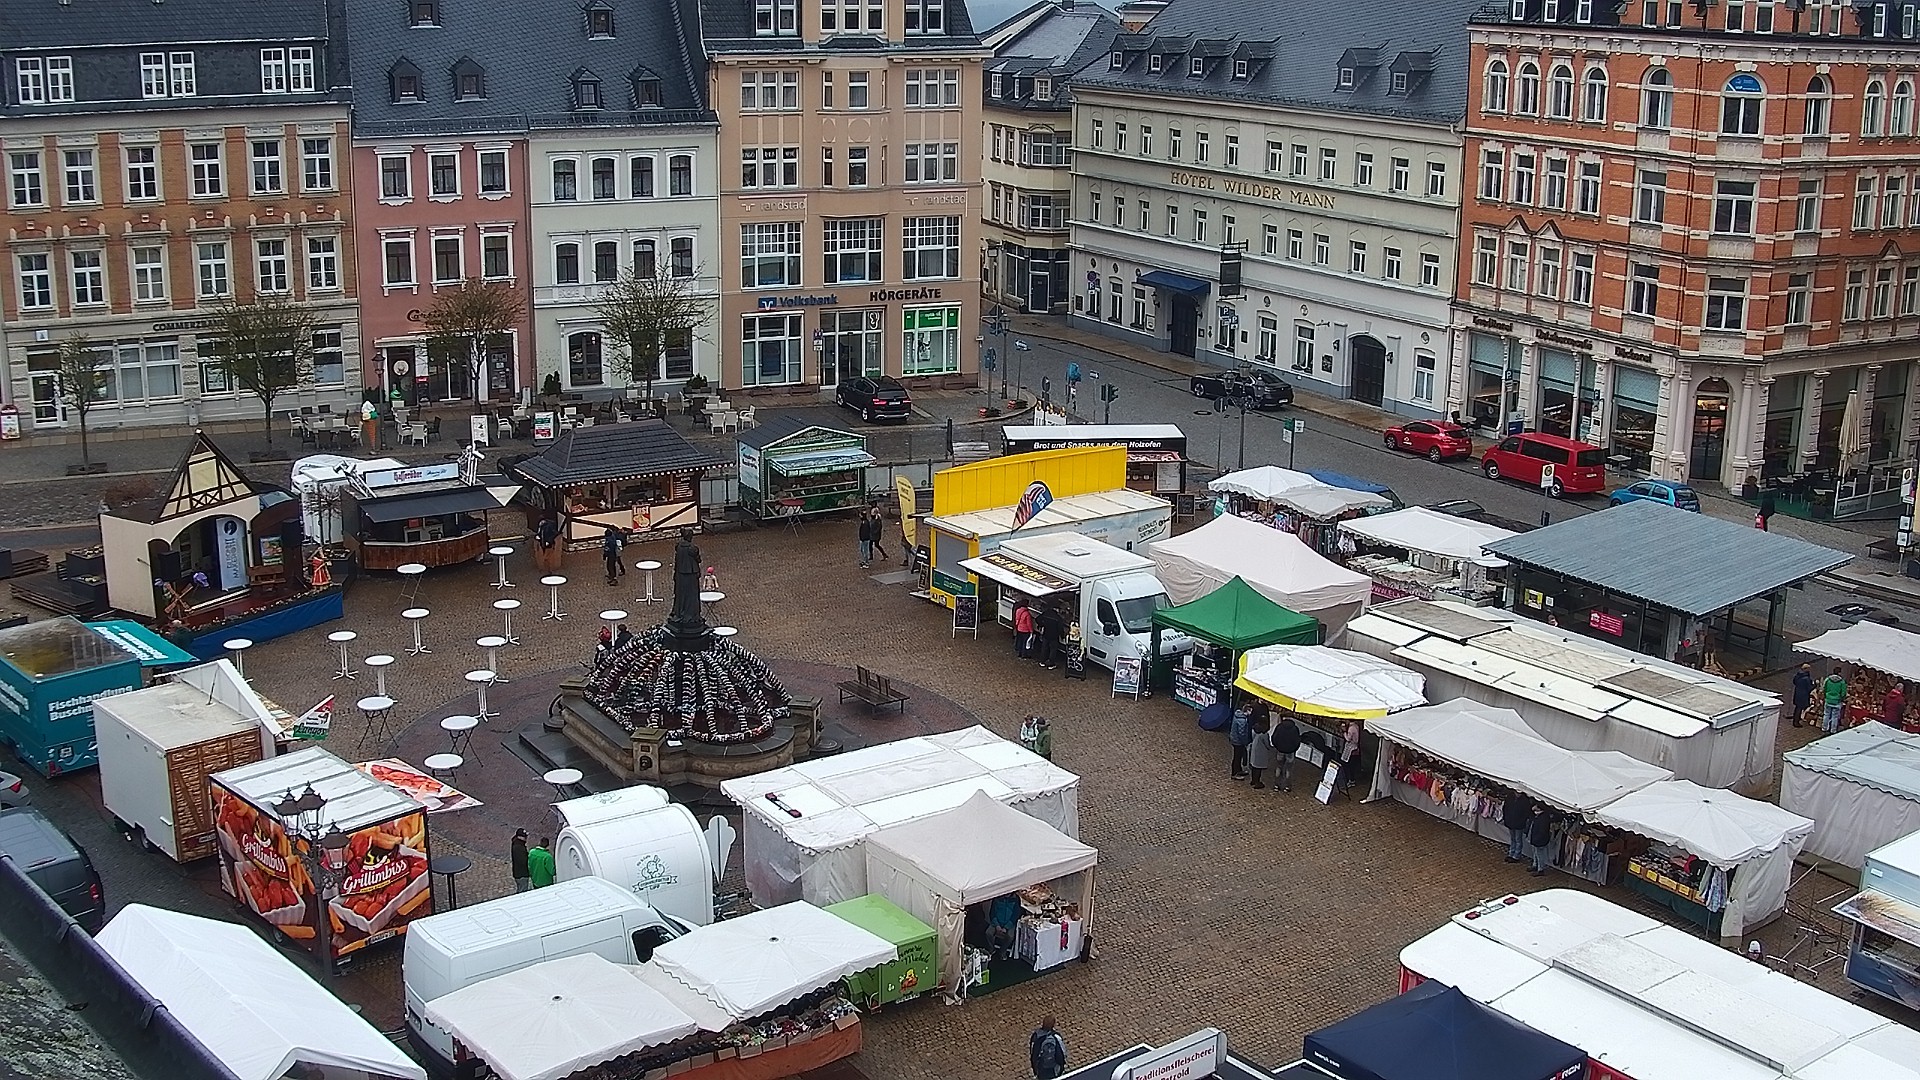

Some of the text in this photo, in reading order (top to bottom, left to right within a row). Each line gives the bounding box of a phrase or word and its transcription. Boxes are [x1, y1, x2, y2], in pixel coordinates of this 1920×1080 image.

[1171, 172, 1336, 209] HOTEL WILDER MANN
[779, 293, 838, 307] Volksbank
[869, 287, 942, 302] HÖRGERÄTE
[1033, 441, 1050, 450] Brot
[1067, 441, 1095, 449] Snacks
[48, 685, 133, 712] Fischhandlung
[49, 704, 94, 721] Buschm
[242, 833, 287, 873] Grillimbiss
[343, 858, 408, 893] Grillimbiss
[1135, 1045, 1215, 1080] Traditionsfleischerei
